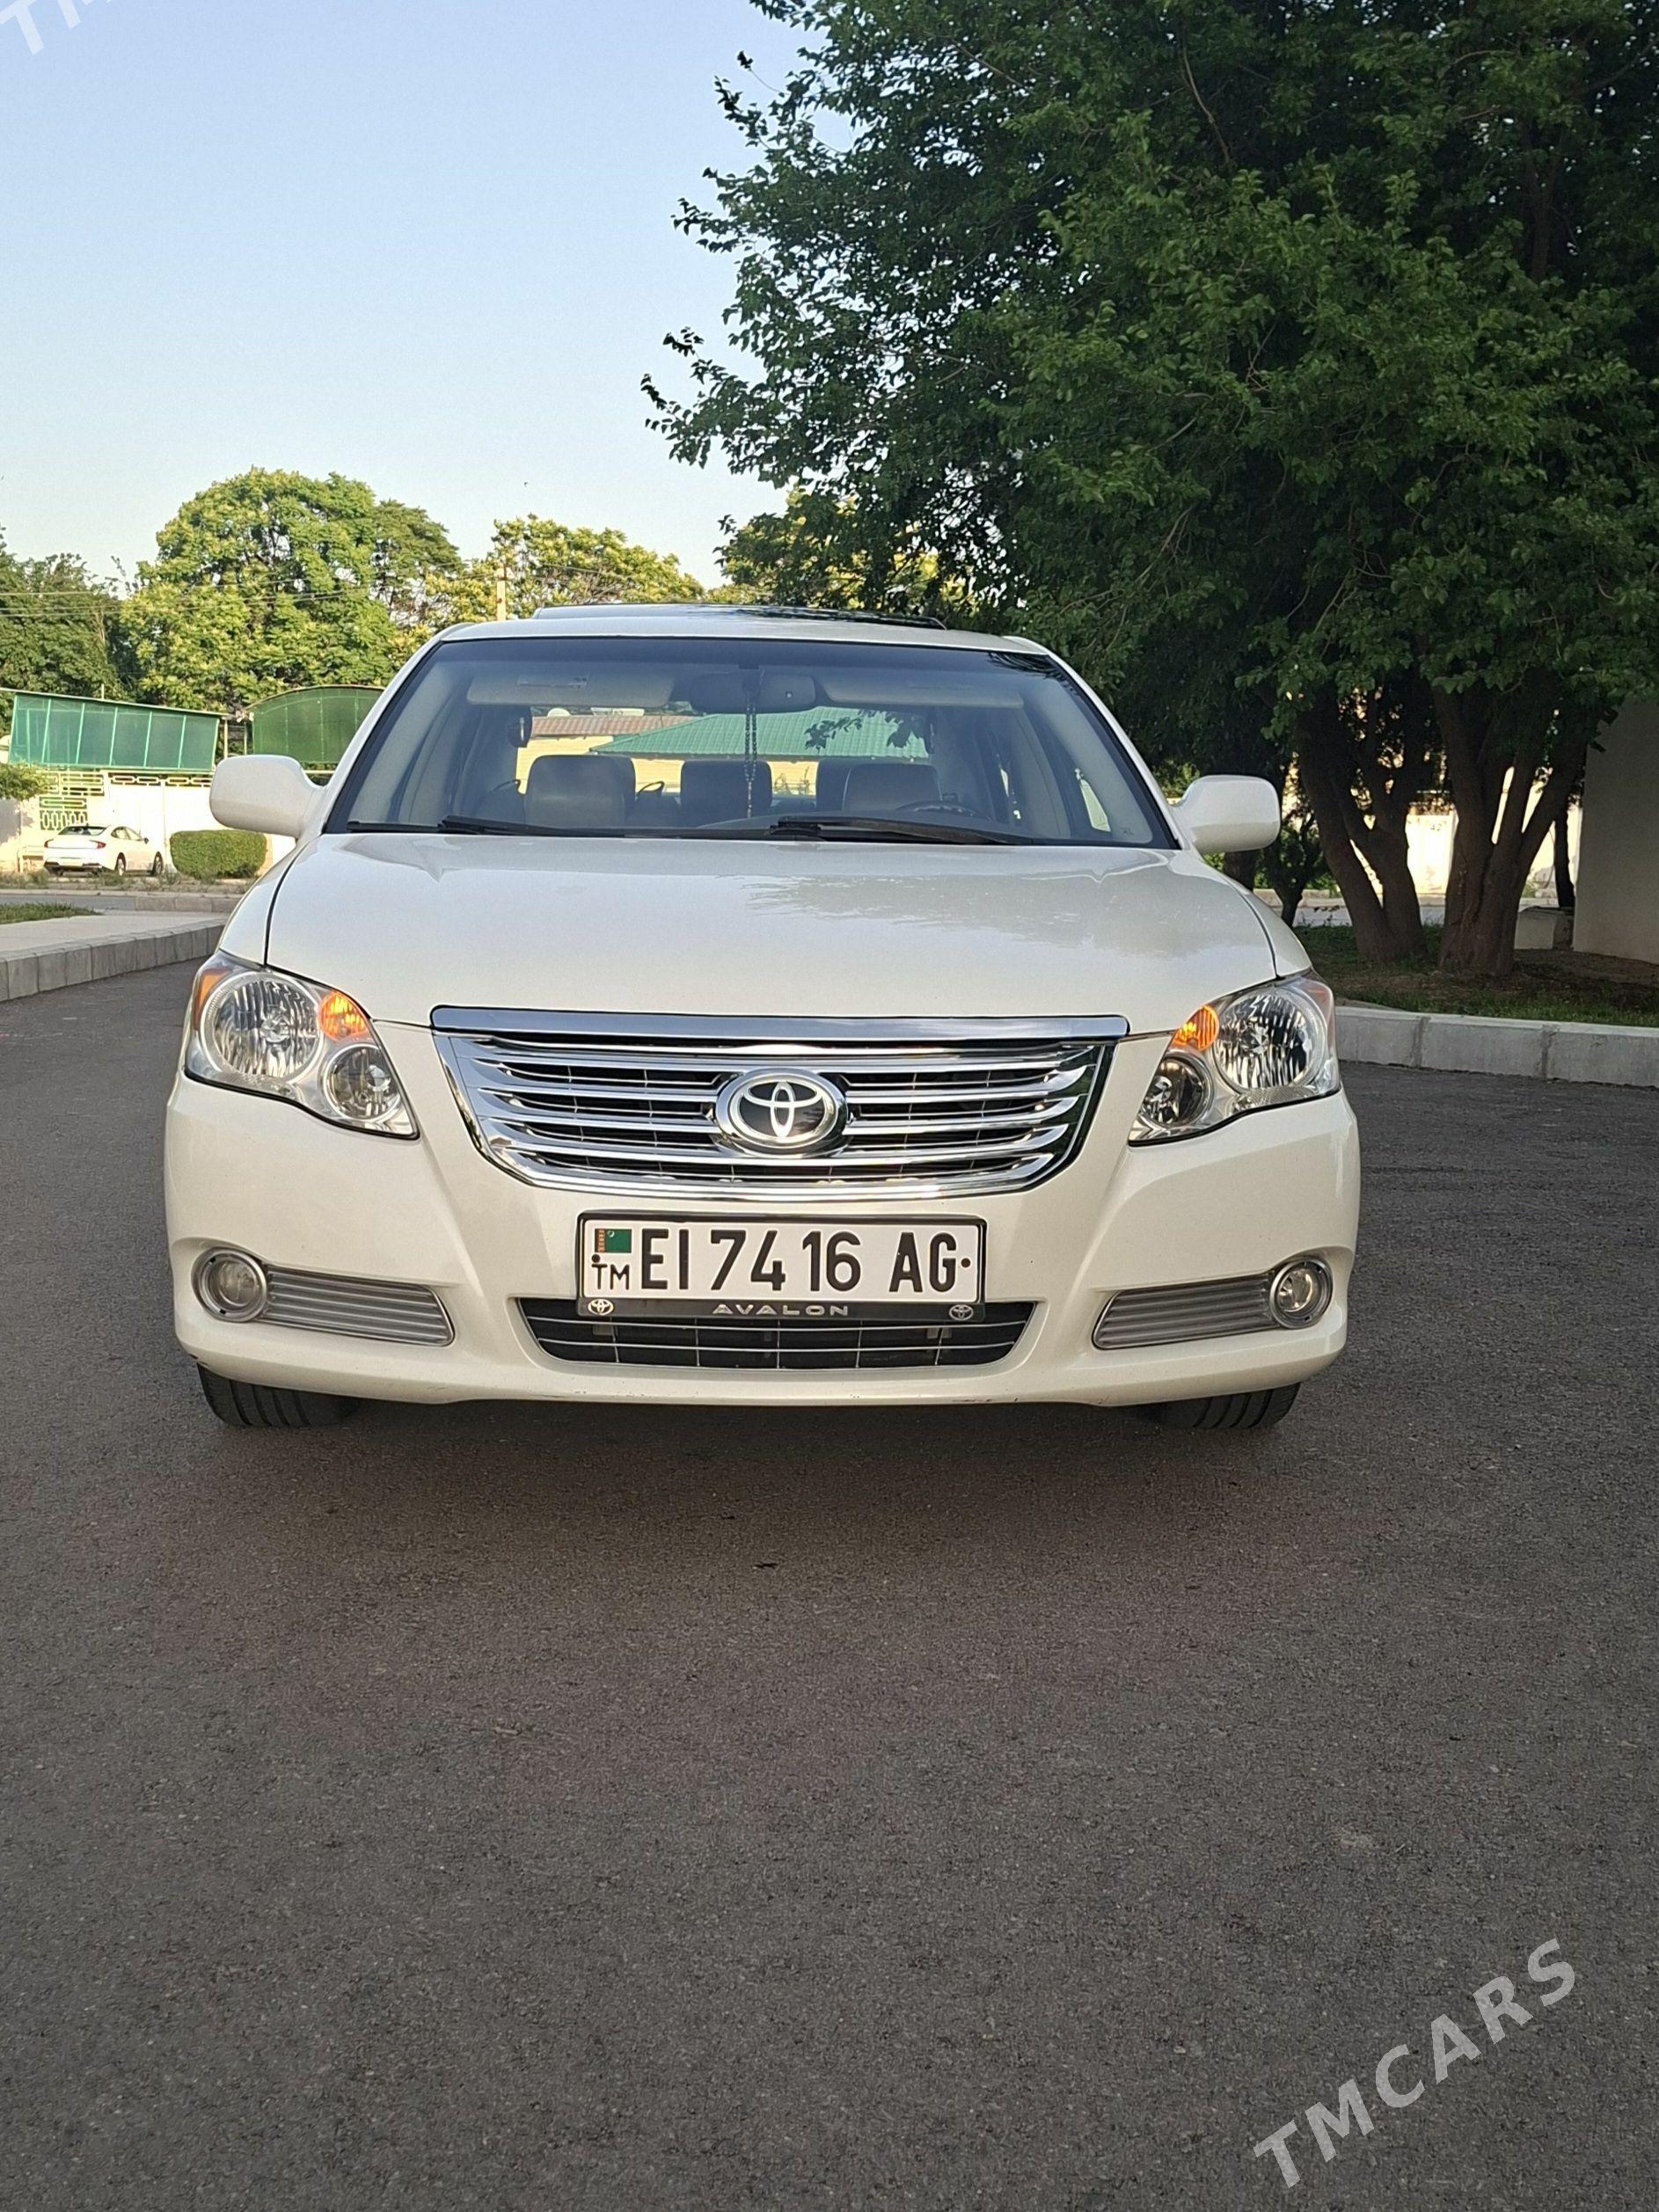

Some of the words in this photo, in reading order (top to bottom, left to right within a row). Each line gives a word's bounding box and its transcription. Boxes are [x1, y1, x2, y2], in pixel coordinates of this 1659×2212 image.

[641, 1228, 689, 1290] EI
[710, 1230, 861, 1292] 7416
[888, 1231, 957, 1293] AG
[591, 1263, 630, 1290] TM
[712, 1303, 849, 1317] AVALON
